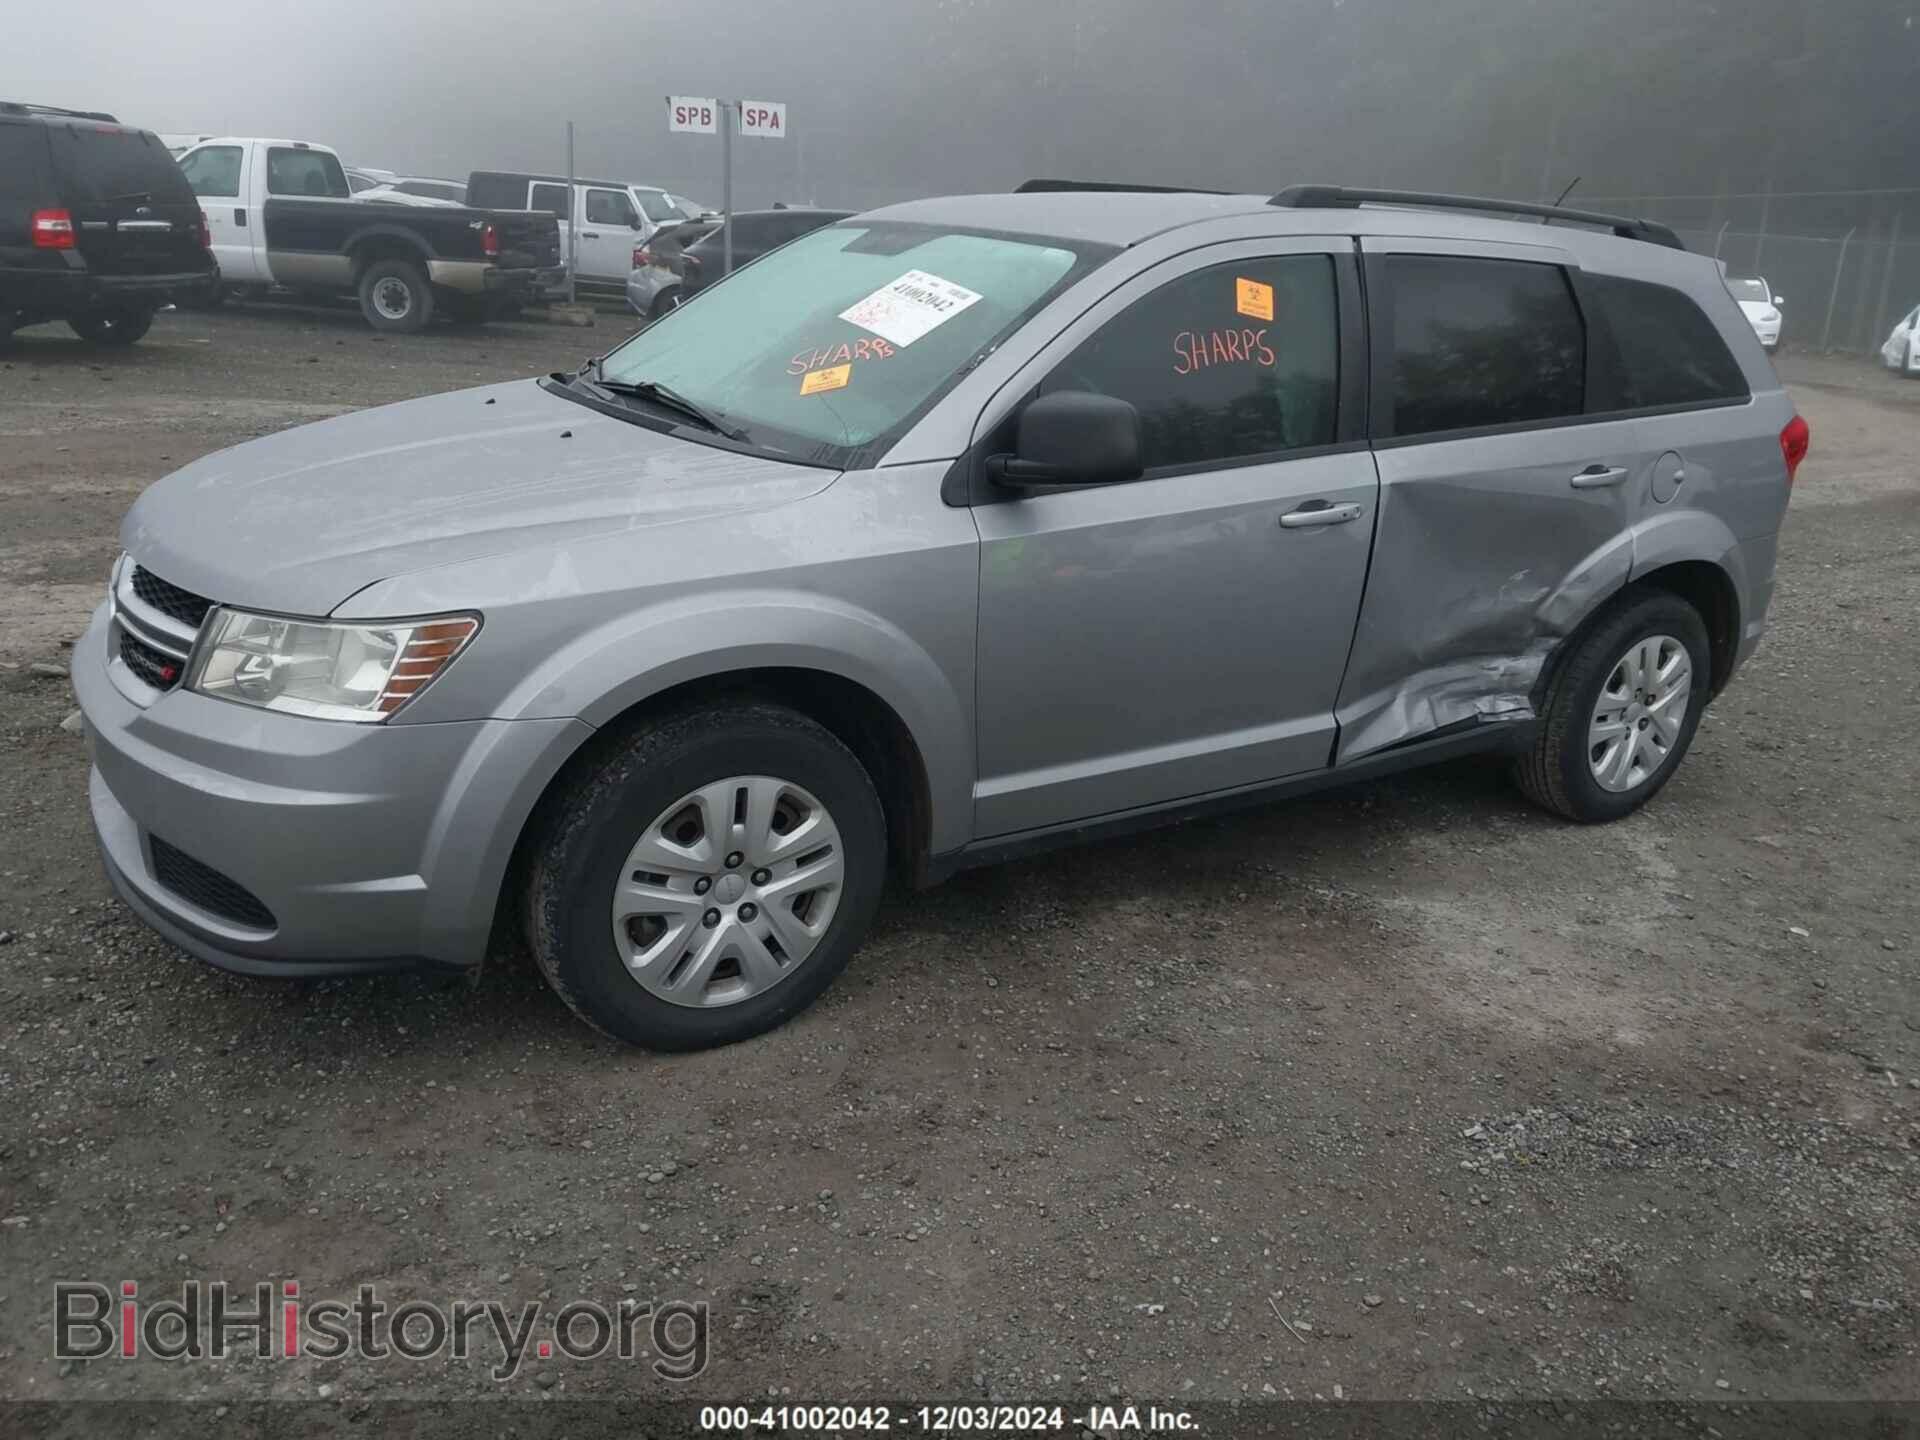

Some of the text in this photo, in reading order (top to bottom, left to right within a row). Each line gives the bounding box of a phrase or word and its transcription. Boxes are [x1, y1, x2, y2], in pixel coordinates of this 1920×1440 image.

[675, 106, 712, 126] SPB
[746, 108, 780, 129] SPA
[787, 338, 895, 375] SHARPS
[1174, 328, 1275, 375] SHARPS
